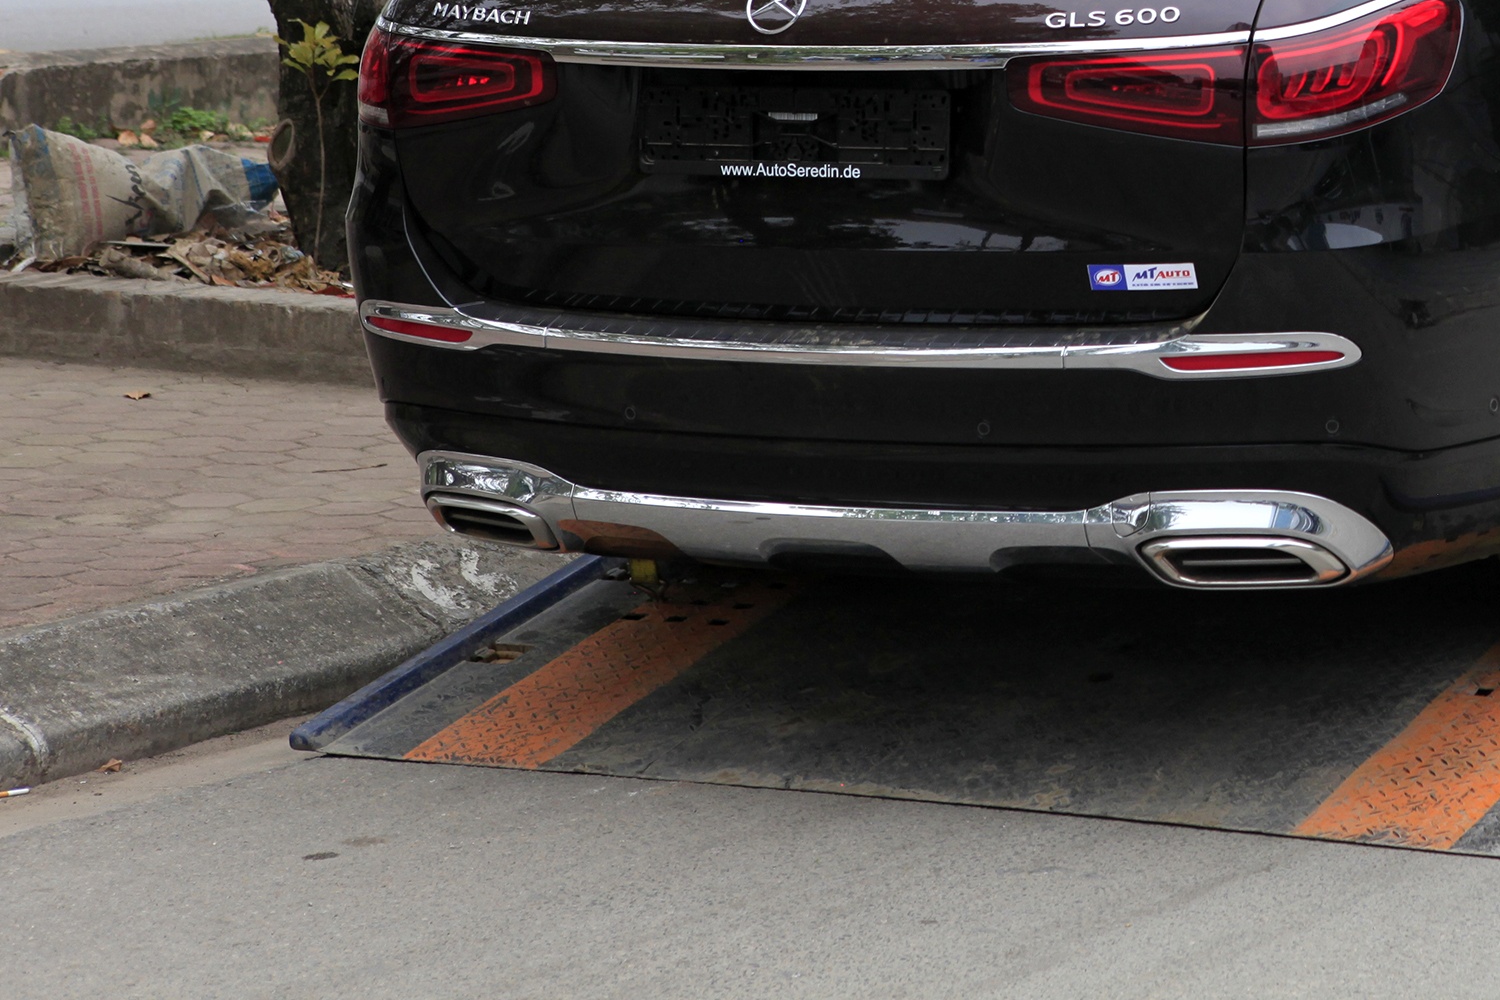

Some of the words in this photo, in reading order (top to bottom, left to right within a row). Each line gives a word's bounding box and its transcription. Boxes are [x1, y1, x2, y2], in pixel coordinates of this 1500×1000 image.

[433, 2, 530, 25] MAYBACH
[1045, 11, 1106, 29] GLS
[1115, 6, 1180, 26] 600
[720, 162, 861, 179] www.AutoSeredin.de
